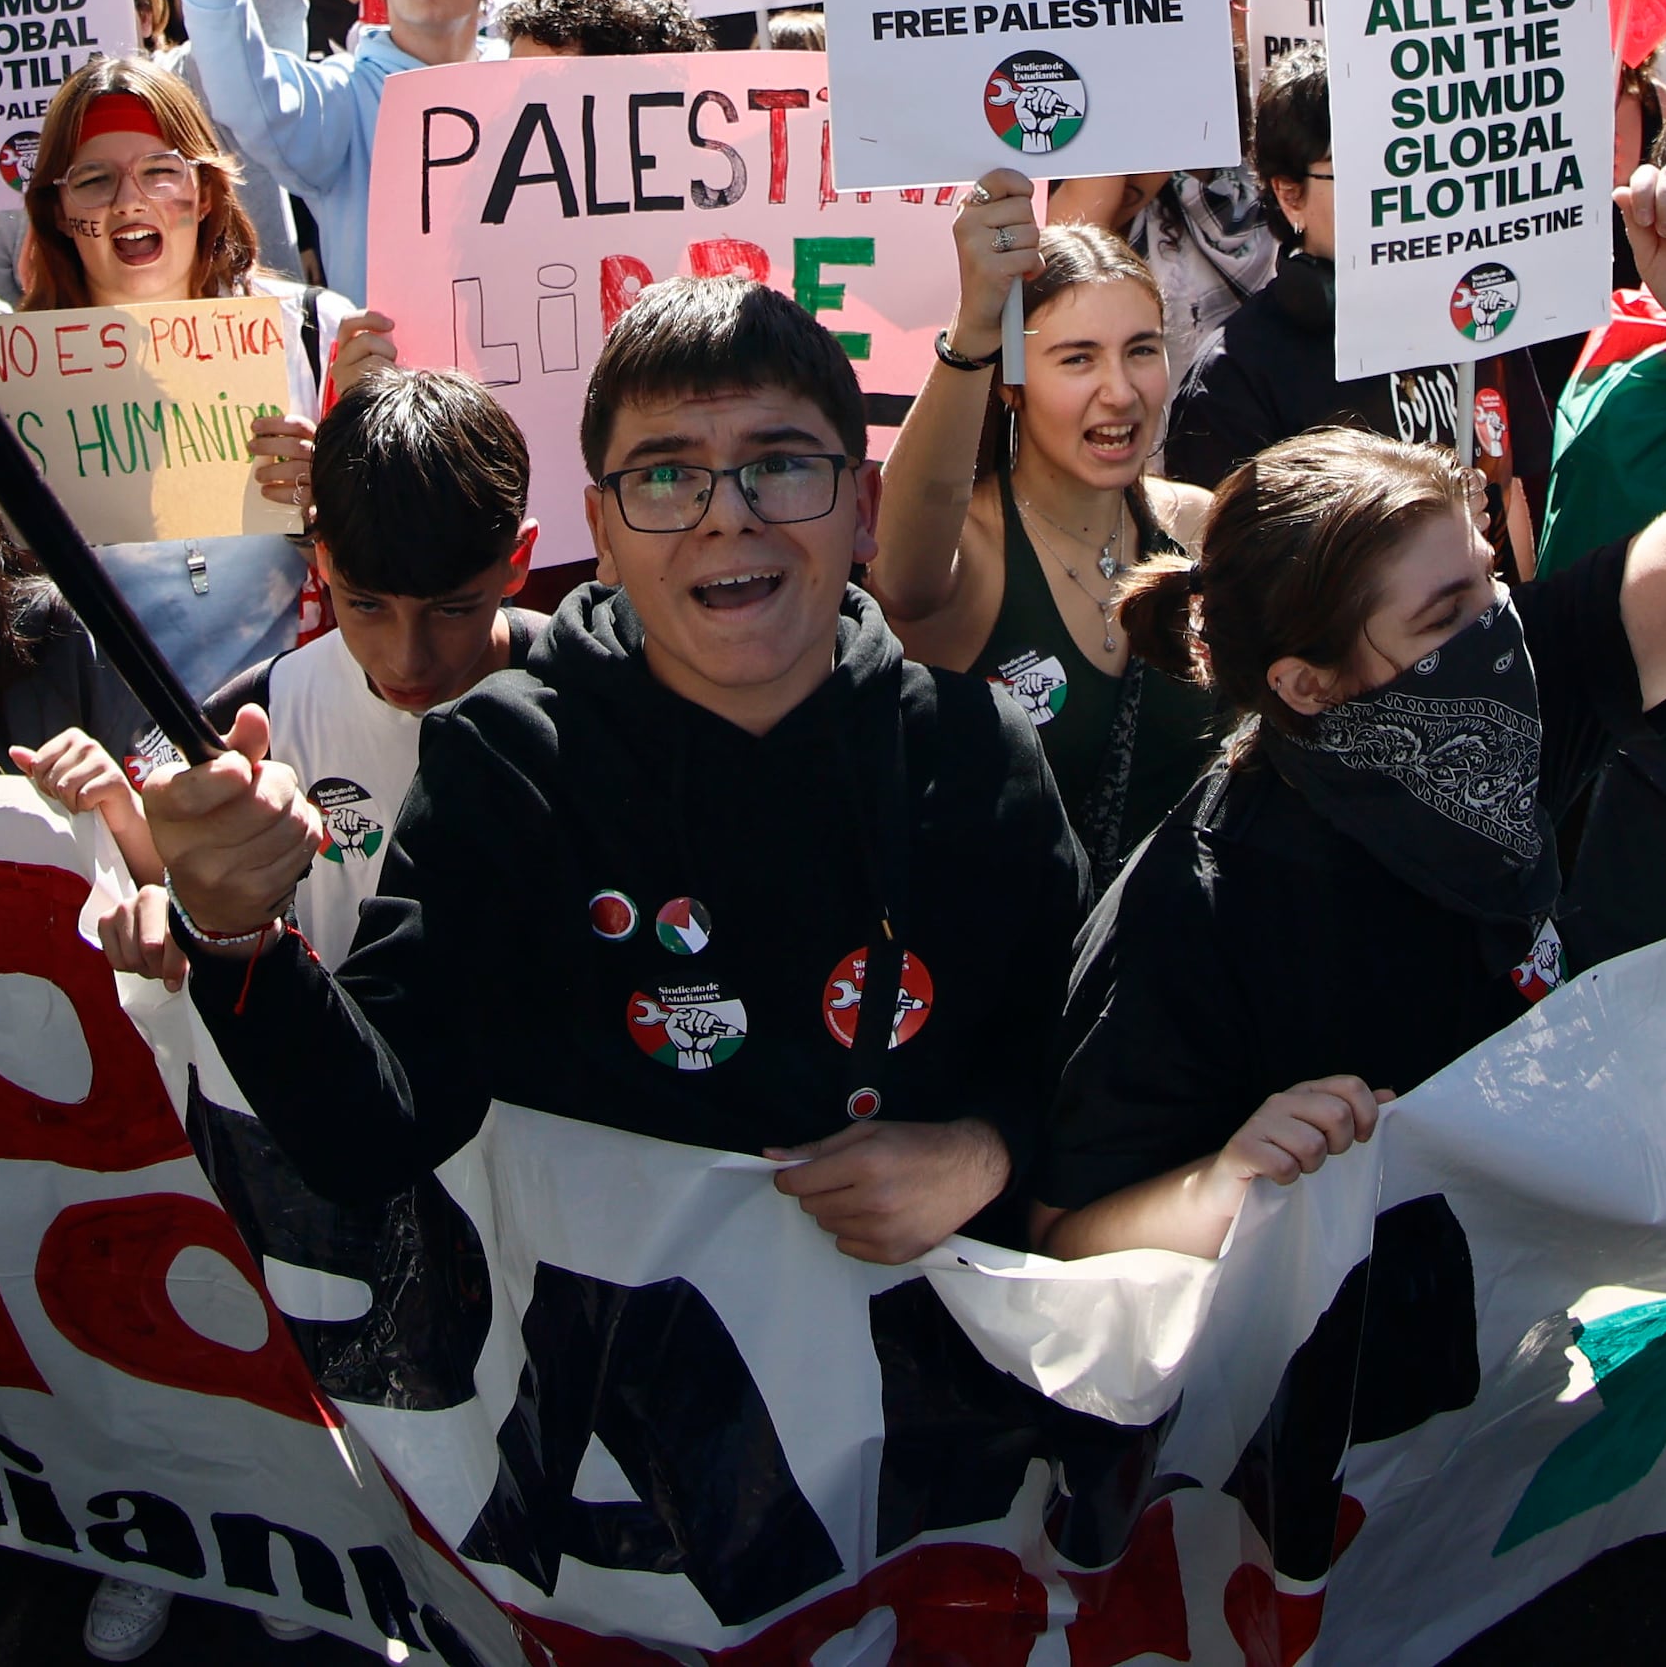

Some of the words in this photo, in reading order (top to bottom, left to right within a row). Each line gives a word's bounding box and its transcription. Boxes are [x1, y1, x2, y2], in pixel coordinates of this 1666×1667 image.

[872, 5, 970, 42] FREE
[1390, 33, 1468, 81] ON
[1473, 18, 1562, 70] THE
[1012, 62, 1053, 73] Sindicato
[1052, 61, 1064, 71] de
[1014, 71, 1064, 82] Estudiantes
[1391, 66, 1565, 132] SUMUD
[1384, 112, 1574, 180] GLOBAL
[1370, 155, 1585, 228] FLOTILLA
[1370, 233, 1443, 267] FREE
[1446, 204, 1584, 258] PALESTINE
[56, 322, 130, 375] ES
[659, 983, 706, 996] Sindicato
[705, 981, 720, 992] de
[661, 990, 721, 1004] Estudiantes
